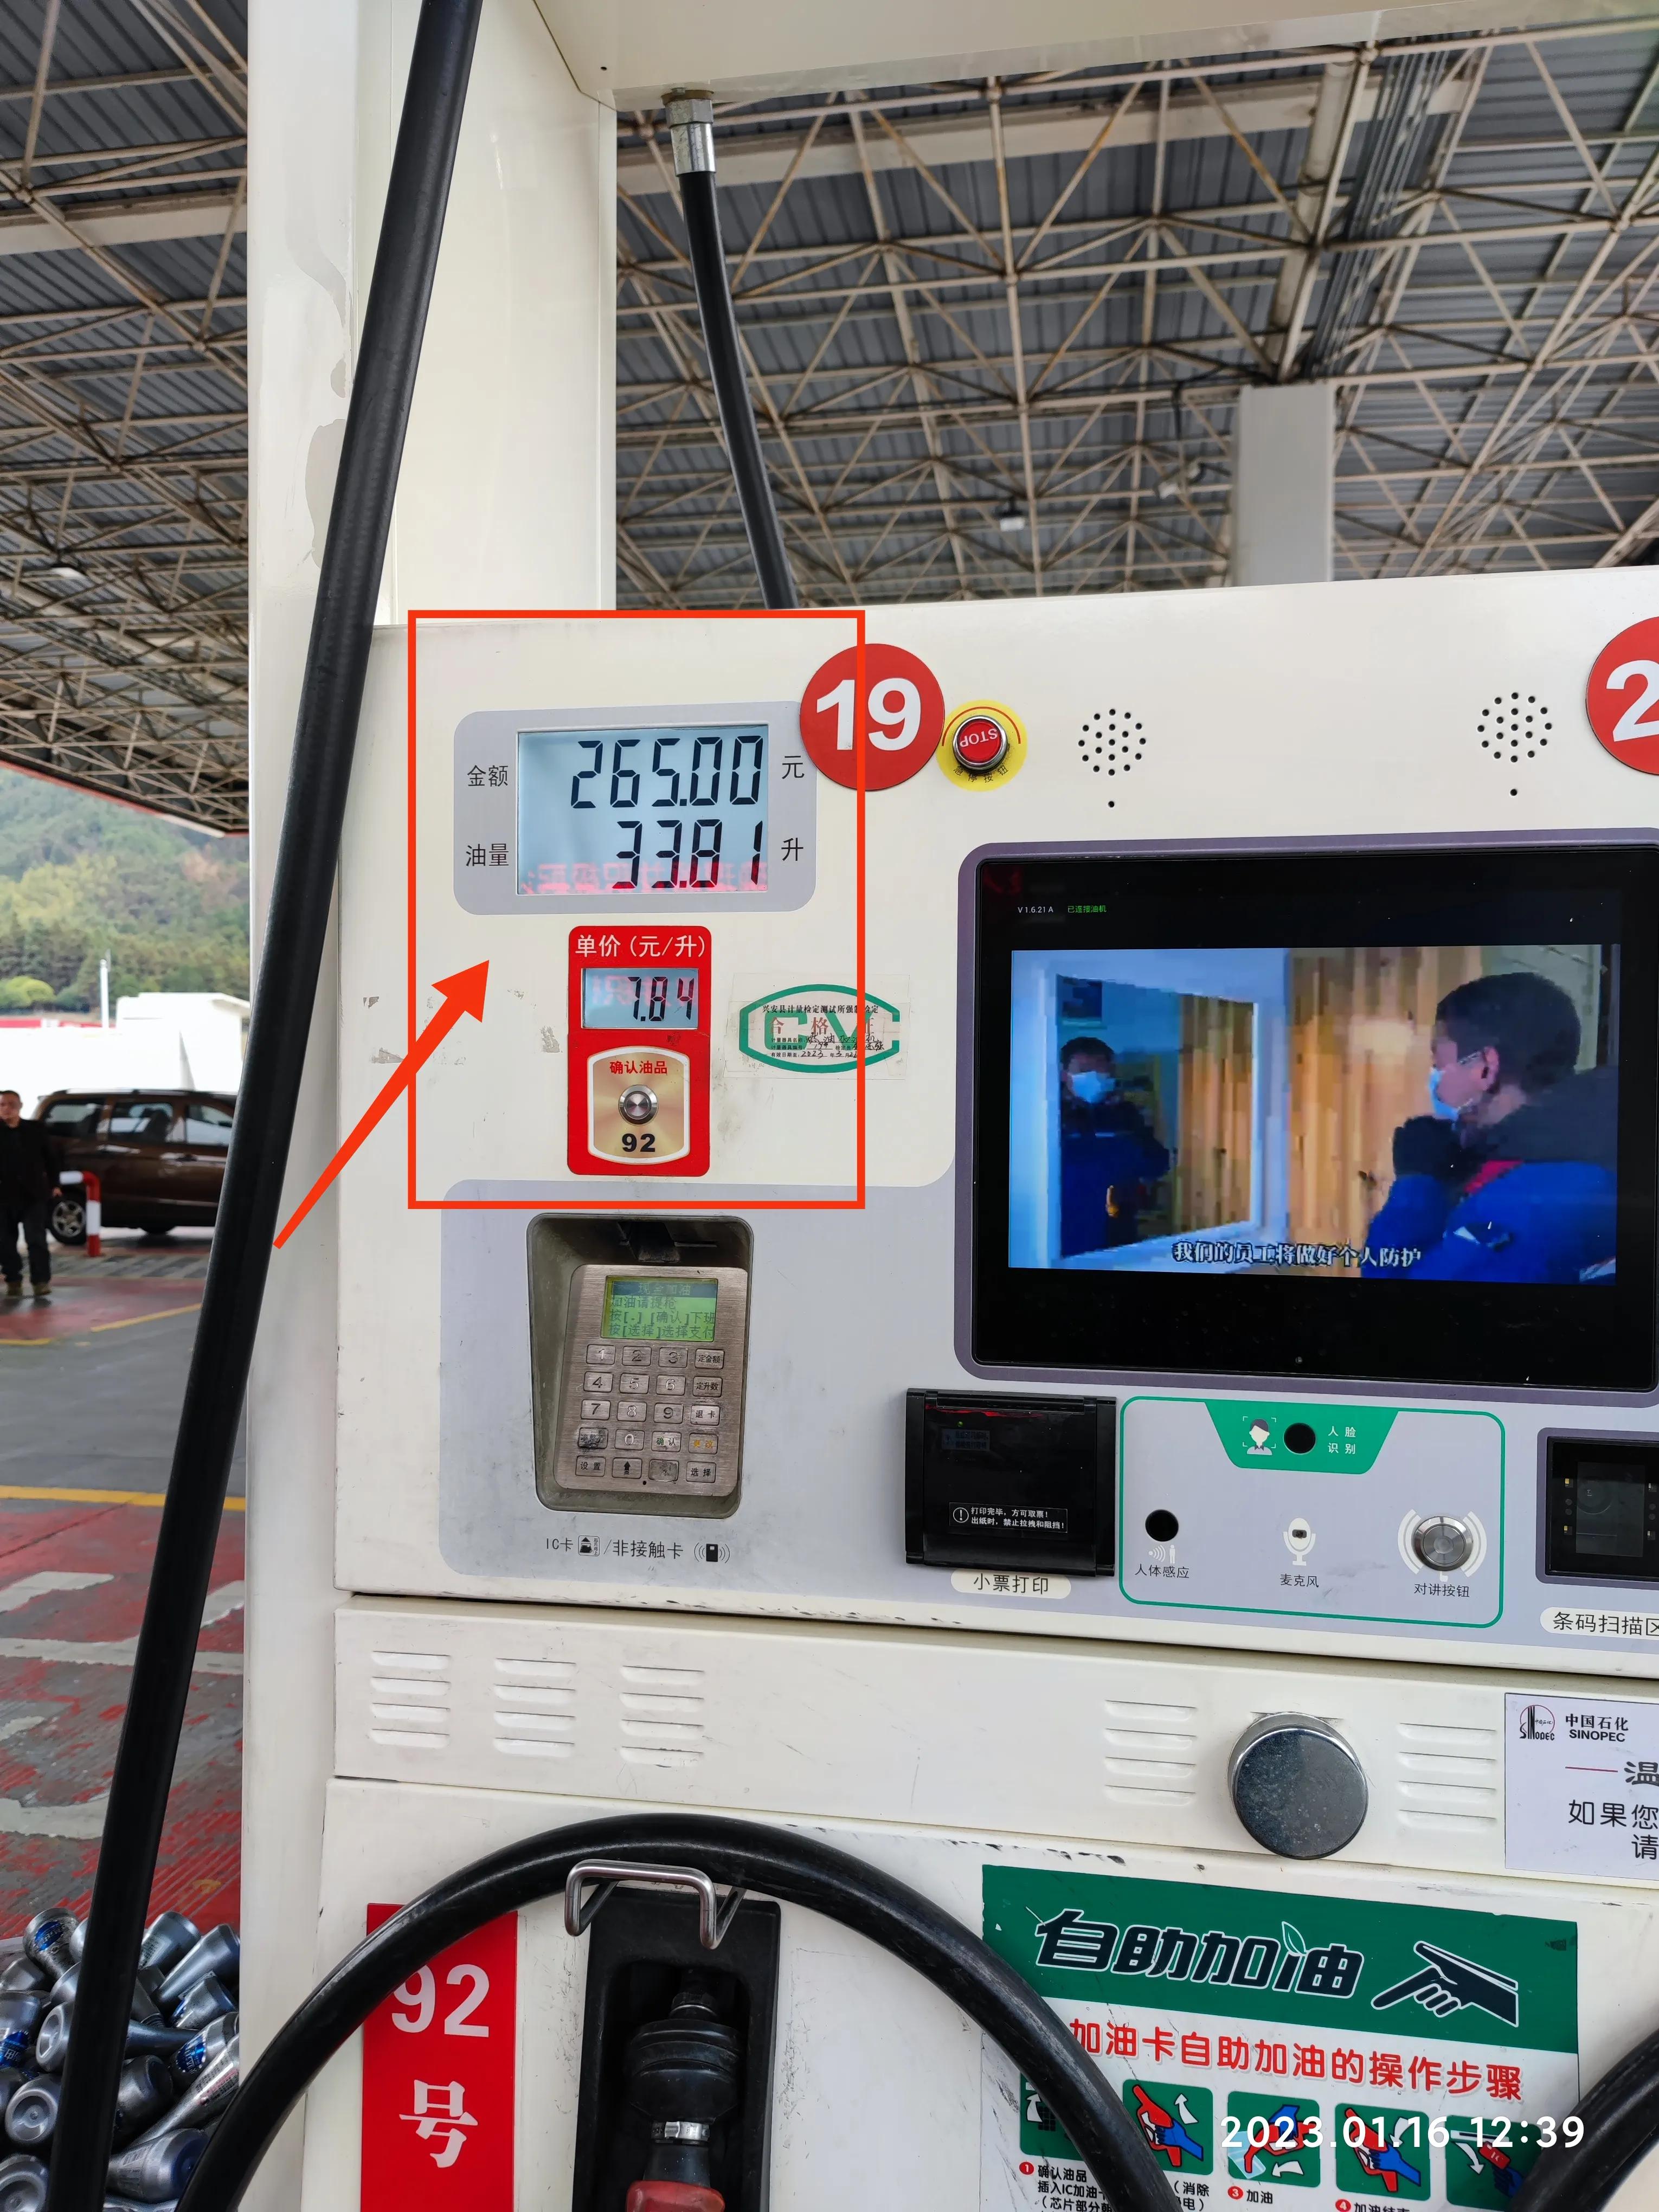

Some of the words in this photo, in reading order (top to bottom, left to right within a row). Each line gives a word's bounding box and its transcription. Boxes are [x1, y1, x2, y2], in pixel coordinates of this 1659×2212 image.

[816, 678, 921, 751] 19
[960, 729, 998, 748] STOP
[571, 735, 763, 808] 265.00
[782, 756, 805, 779] 元
[467, 765, 509, 787] 金额
[466, 843, 510, 867] 油量
[612, 819, 763, 888] 33.81
[781, 838, 804, 861] 升
[628, 976, 695, 1021] 7.84
[609, 1060, 667, 1075] 确认油品
[622, 1133, 655, 1153] 92
[1173, 1240, 1422, 1268] 我们的员工将做好个人防护
[598, 1348, 605, 1361] 1
[632, 1349, 642, 1362] 2
[668, 1352, 678, 1364] 3
[698, 1355, 721, 1364] 定金额
[592, 1376, 603, 1388] 4
[629, 1378, 640, 1390] 5
[665, 1379, 676, 1391] 6
[696, 1381, 718, 1391] 定升数
[591, 1403, 601, 1416] 7
[627, 1405, 637, 1417] 8
[663, 1407, 674, 1419] 9
[695, 1410, 716, 1419] 退卡
[1328, 1425, 1356, 1438] 人脸
[624, 1433, 635, 1446] 0
[656, 1437, 676, 1446] 确认
[1328, 1443, 1356, 1455] 识别
[580, 1462, 601, 1471] 设置
[691, 1467, 712, 1477] 选择
[546, 1538, 574, 1552] IC卡
[1135, 1564, 1189, 1579] 人体感应
[973, 1573, 1049, 1595] 小票打印
[1279, 1573, 1320, 1589] 麦克风
[1413, 1582, 1471, 1598] 对讲按钮
[1552, 1611, 1659, 1638] 条码扫描区
[1565, 1713, 1629, 1731] 中国石化
[1569, 1729, 1625, 1742] SINOPEC
[1624, 1761, 1659, 1787] 温
[1568, 1799, 1659, 1830] 如果您
[1631, 1834, 1659, 1860] 请
[1034, 1908, 1365, 1999] 自助加油
[392, 1963, 490, 2037] 92
[1070, 2018, 1522, 2102] 加油卡自助加油的操作步骤
[399, 2079, 478, 2168] 号
[1246, 2189, 1274, 2204] 加油
